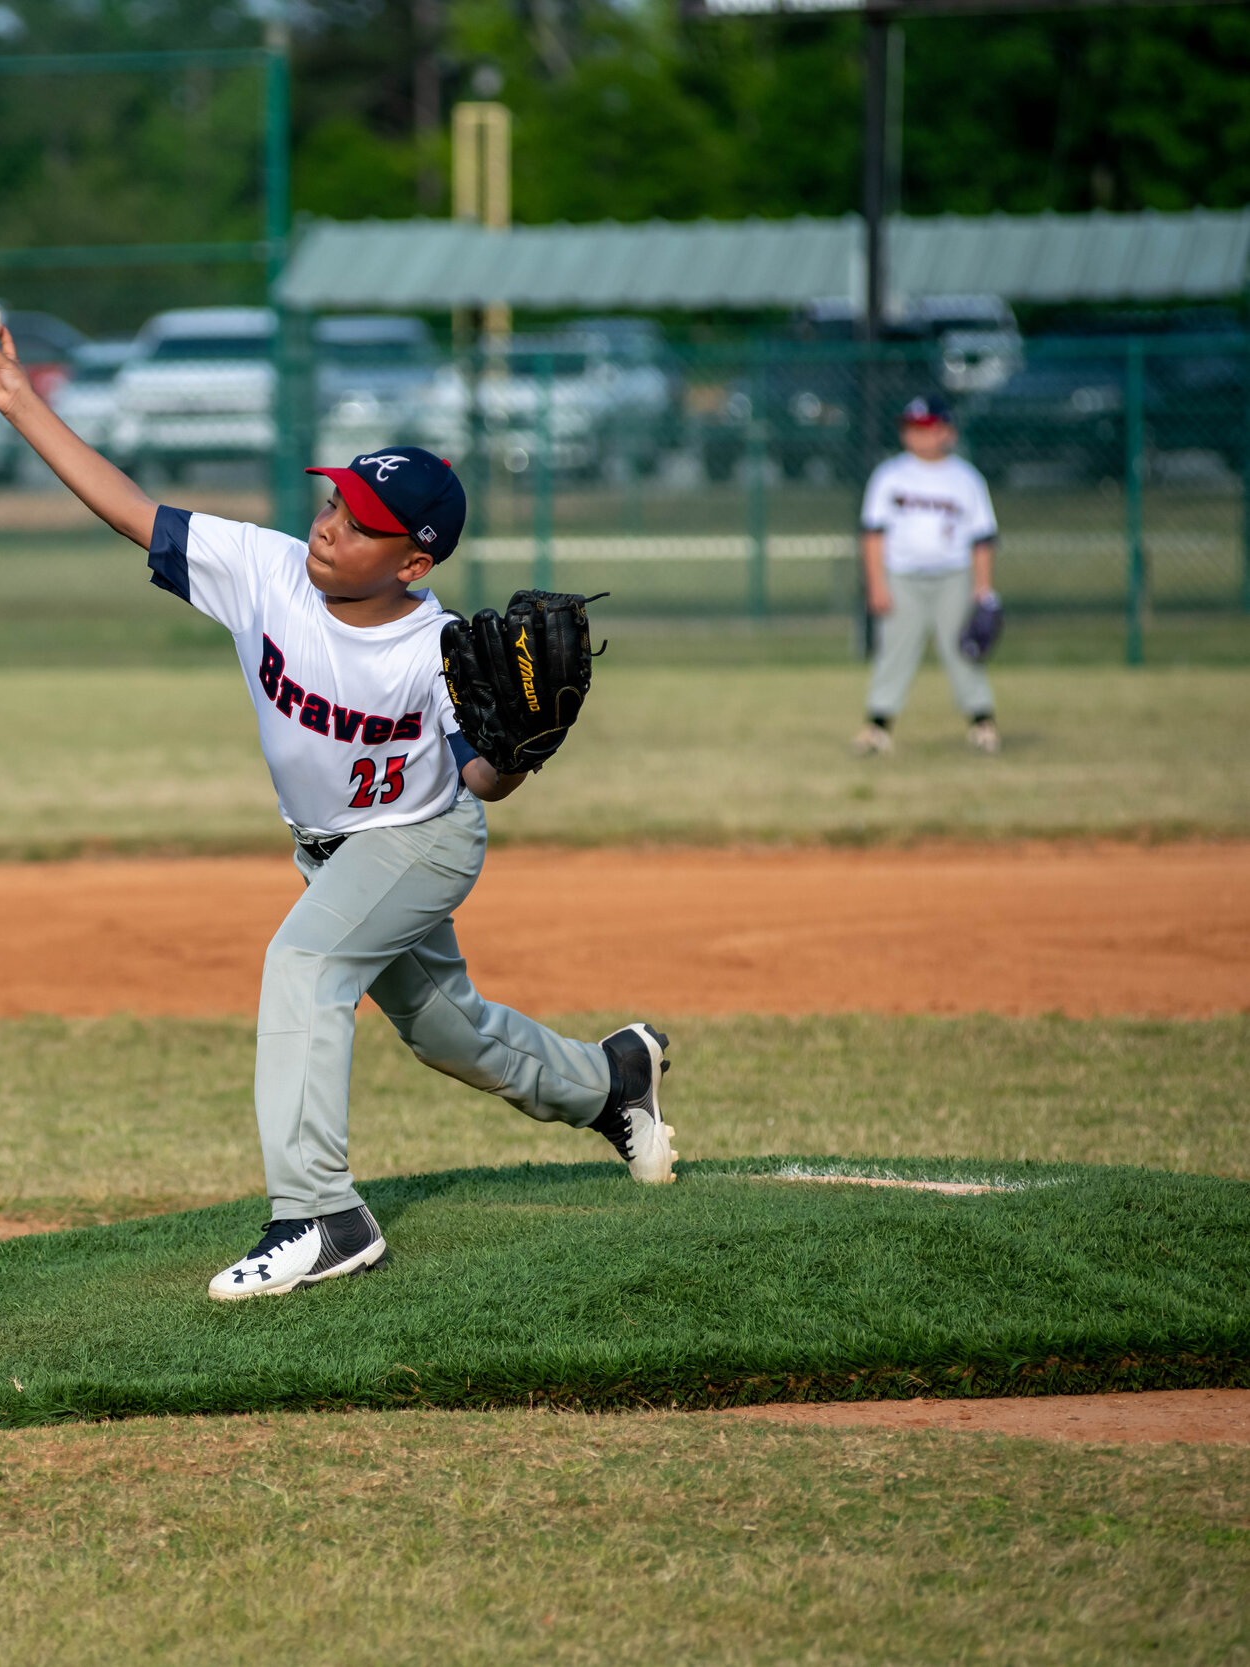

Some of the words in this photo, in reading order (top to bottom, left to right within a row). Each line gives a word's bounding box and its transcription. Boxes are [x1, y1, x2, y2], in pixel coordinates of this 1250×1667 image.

[359, 455, 410, 482] A
[259, 632, 423, 746] Braves
[348, 752, 409, 808] 25
